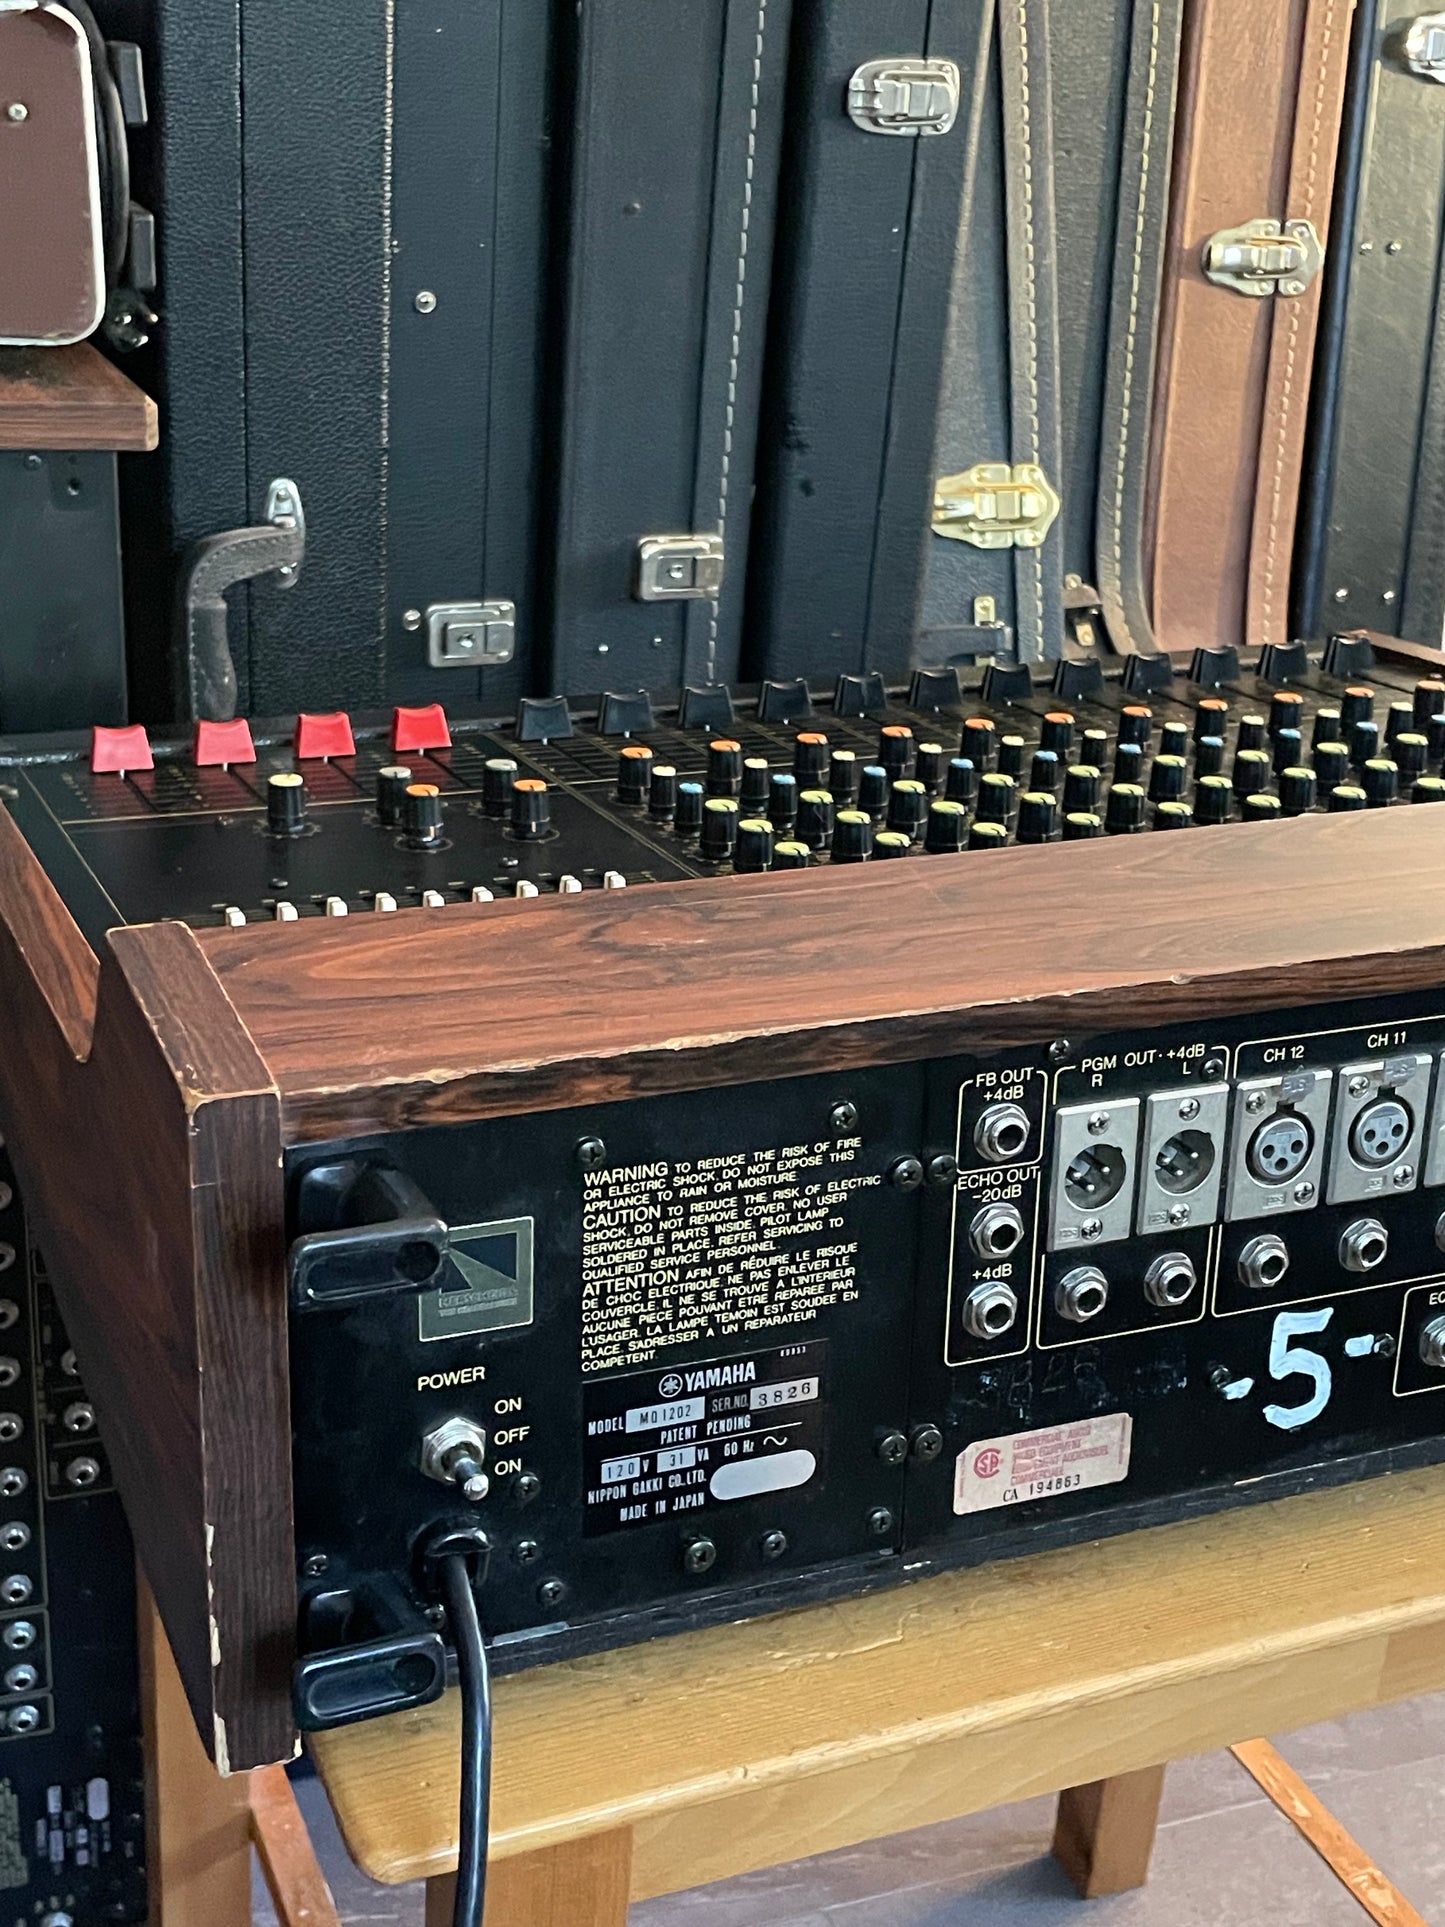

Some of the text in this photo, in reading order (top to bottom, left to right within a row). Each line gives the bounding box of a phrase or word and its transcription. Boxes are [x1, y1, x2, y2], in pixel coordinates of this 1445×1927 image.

[1264, 1046, 1305, 1063] CH 12
[1364, 1032, 1406, 1048] CH 11
[1082, 1055, 1117, 1073] PGM
[1166, 1043, 1206, 1059] +4dB
[1182, 1062, 1192, 1074] L
[976, 1066, 1034, 1088] FB OUT
[1092, 1074, 1103, 1088] R
[984, 1084, 1024, 1101] +4dB
[584, 1137, 861, 1187] WARNING TO REDUCE THE RISK OF FIRE
[584, 1188, 602, 1200] OR
[608, 1178, 666, 1196] ELECTRIC
[722, 1168, 740, 1180] DO
[747, 1162, 770, 1176] NOT
[777, 1154, 822, 1171] EXPOSE
[830, 1150, 854, 1162] THIS
[958, 1166, 1040, 1190] ECHO OUT
[583, 1175, 881, 1230] CAUTION TO REDUCE THE RISK OF ELECTRIC
[584, 1194, 650, 1213] APPLIANCE
[657, 1190, 672, 1201] TO
[680, 1185, 707, 1198] RAIN
[714, 1181, 732, 1193] OR
[972, 1184, 1022, 1202] -20dB
[634, 1223, 652, 1235] DO
[660, 1218, 684, 1231] NOT
[689, 1209, 738, 1226] REMOVE
[793, 1198, 810, 1209] NO
[817, 1192, 847, 1206] USER
[583, 1233, 664, 1256] SERVICEABLE
[672, 1227, 708, 1241] PARTS
[760, 1214, 791, 1226] PILOT
[798, 1208, 829, 1221] LAMP
[583, 1217, 844, 1268] SOLDERED IN PLACE. REFER SERVICING TO
[582, 1262, 644, 1280] QUALIFIED
[650, 1253, 700, 1270] SERVICE
[583, 1242, 858, 1298] ATTENTION AFIN DE RÉDUIRE LE RISQUE
[972, 1263, 1012, 1279] +4dB
[582, 1298, 599, 1310] DE
[606, 1291, 642, 1306] CHOC
[728, 1274, 743, 1285] NE
[750, 1269, 772, 1280] PAS
[778, 1259, 829, 1276] ENLEVER
[836, 1256, 850, 1267] LE
[662, 1299, 673, 1308] IL
[679, 1294, 695, 1305] NE
[701, 1290, 717, 1302] SE
[724, 1282, 769, 1298] TROUVE
[776, 1279, 785, 1289] A
[582, 1279, 853, 1334] AUCUNE PIECE POUVANT ETRE REPAREE PAR
[647, 1325, 662, 1336] LA
[669, 1316, 708, 1332] LAMPE
[714, 1308, 758, 1323] TEMOIN
[764, 1302, 785, 1315] EST
[791, 1294, 837, 1310] SOUDEE
[843, 1290, 858, 1301] EN
[706, 1328, 715, 1338] A
[722, 1323, 738, 1334] UN
[744, 1309, 816, 1330] REPARATEUR
[418, 1366, 485, 1391] POWER
[684, 1362, 756, 1392] YAMAHA
[494, 1397, 522, 1414] ON
[588, 1417, 624, 1436] MODEL
[758, 1382, 810, 1406] 3826
[494, 1426, 530, 1445] OFF
[661, 1414, 751, 1444] PATENT PENDING
[494, 1458, 522, 1475] ON
[608, 1462, 635, 1479] 120
[642, 1459, 649, 1472] V
[670, 1452, 683, 1466] 31
[698, 1448, 709, 1462] VA
[724, 1442, 738, 1456] 60
[588, 1485, 627, 1504] NIPPON
[633, 1478, 662, 1496] GAKKI
[1003, 1489, 1018, 1502] CA
[620, 1492, 704, 1521] MADE IN JAPAN
